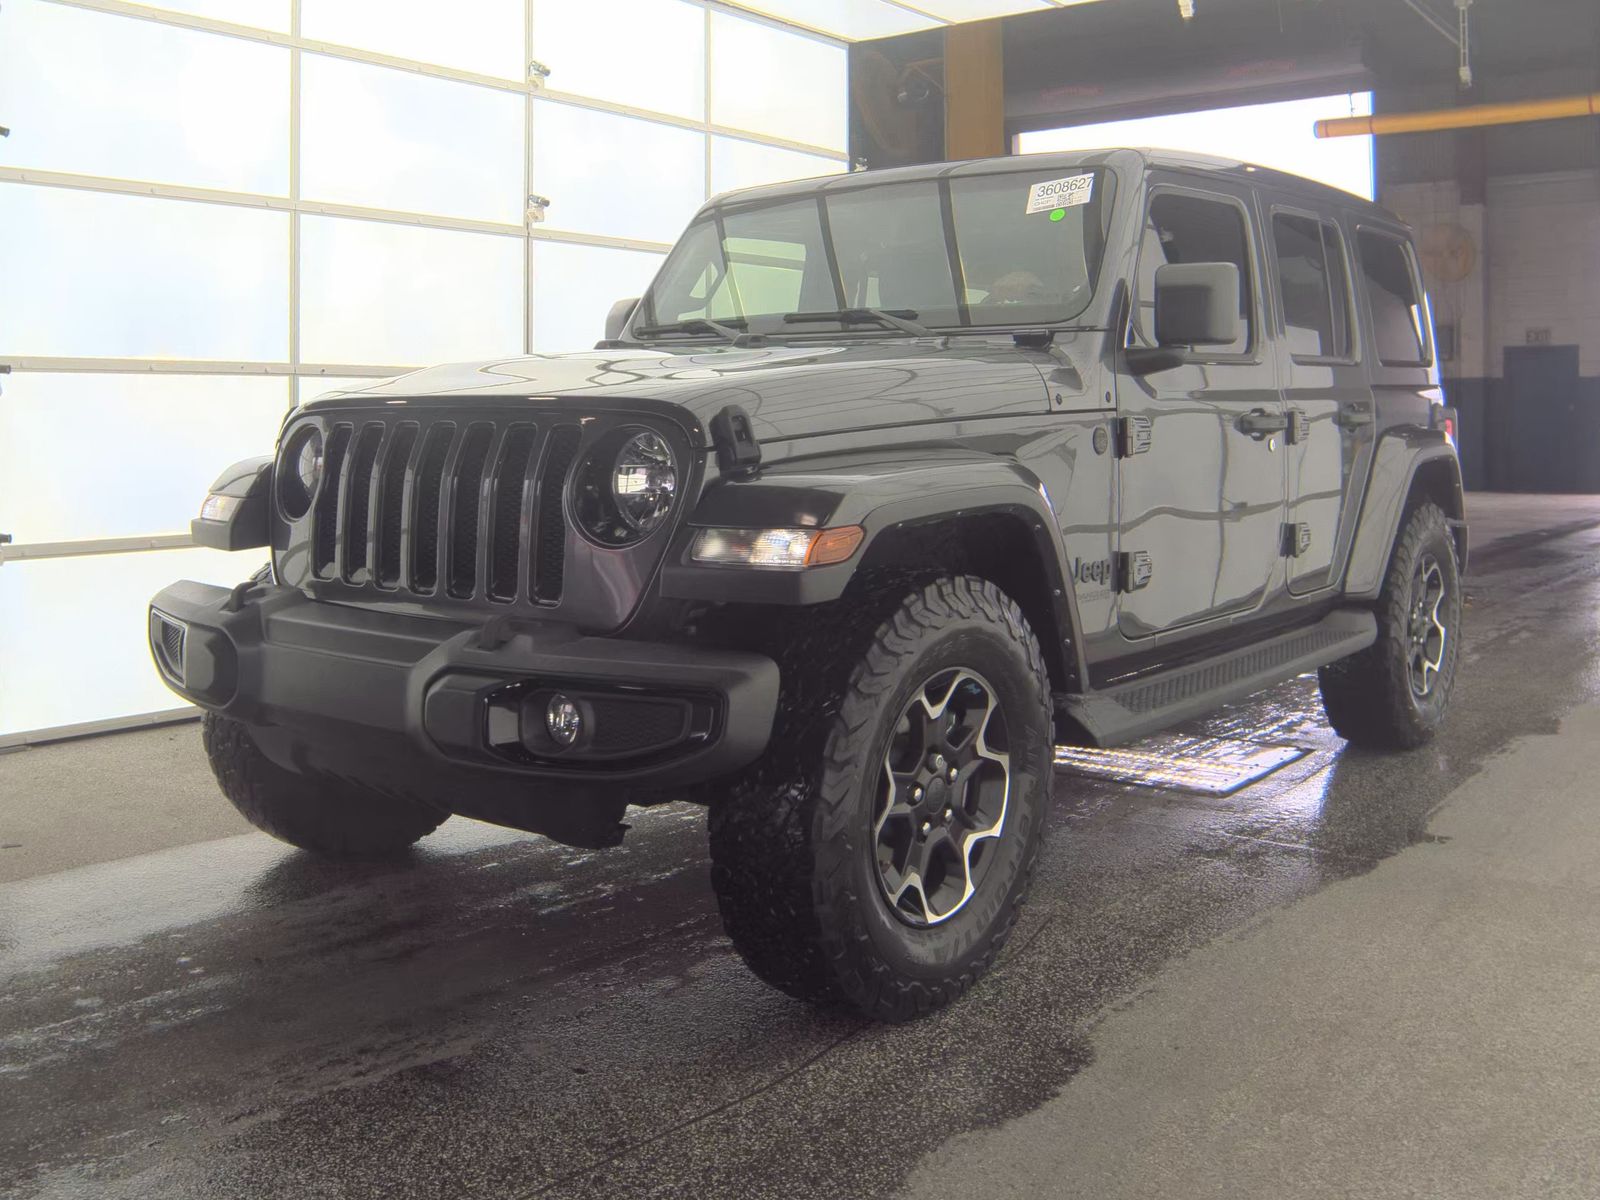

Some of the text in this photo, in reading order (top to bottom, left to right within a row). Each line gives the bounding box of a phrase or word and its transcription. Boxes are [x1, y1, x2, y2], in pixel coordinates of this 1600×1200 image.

[1037, 176, 1093, 197] 3608627
[1526, 329, 1551, 344] EXIT
[1073, 557, 1111, 586] Jeep
